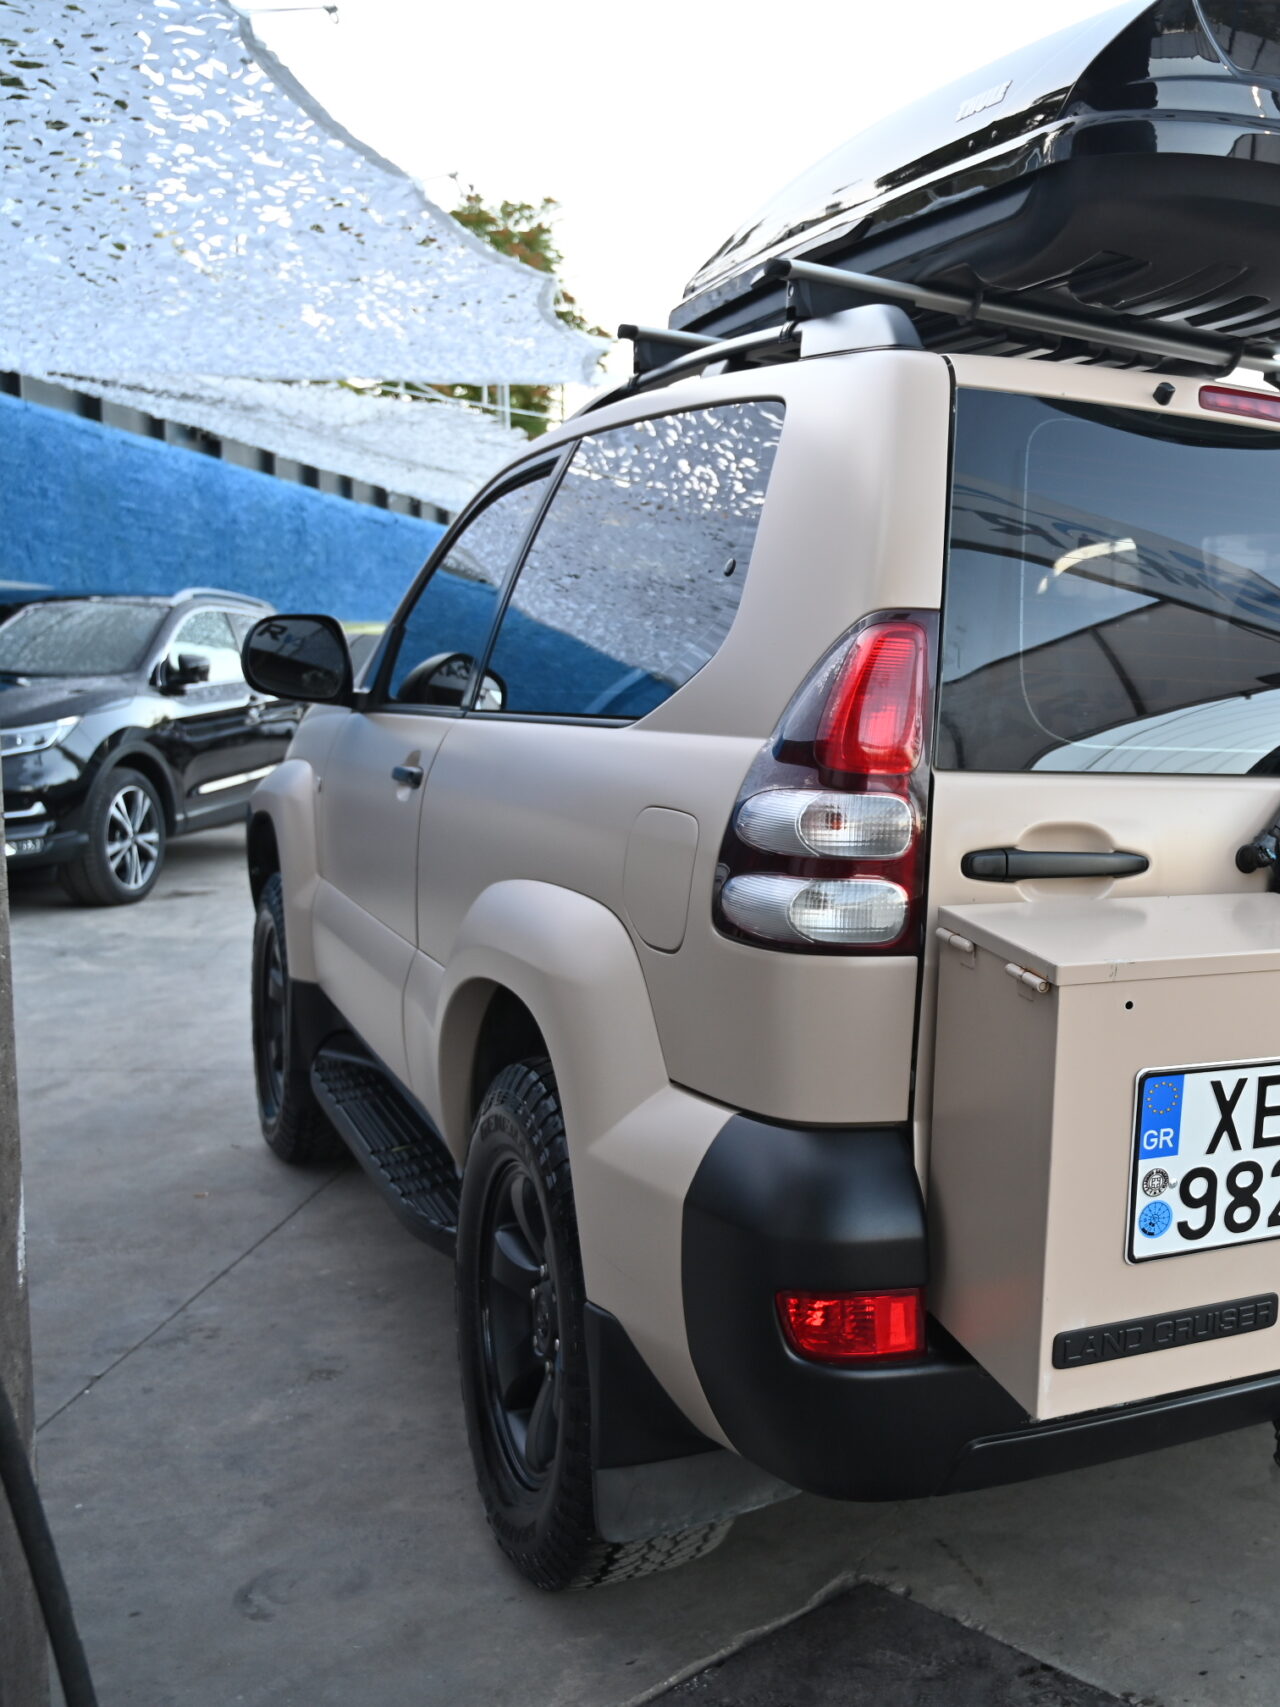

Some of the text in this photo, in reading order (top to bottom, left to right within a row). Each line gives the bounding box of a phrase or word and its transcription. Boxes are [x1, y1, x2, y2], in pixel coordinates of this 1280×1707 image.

[1143, 1127, 1174, 1150] GR
[1063, 1300, 1274, 1363] LAND CRUISER
